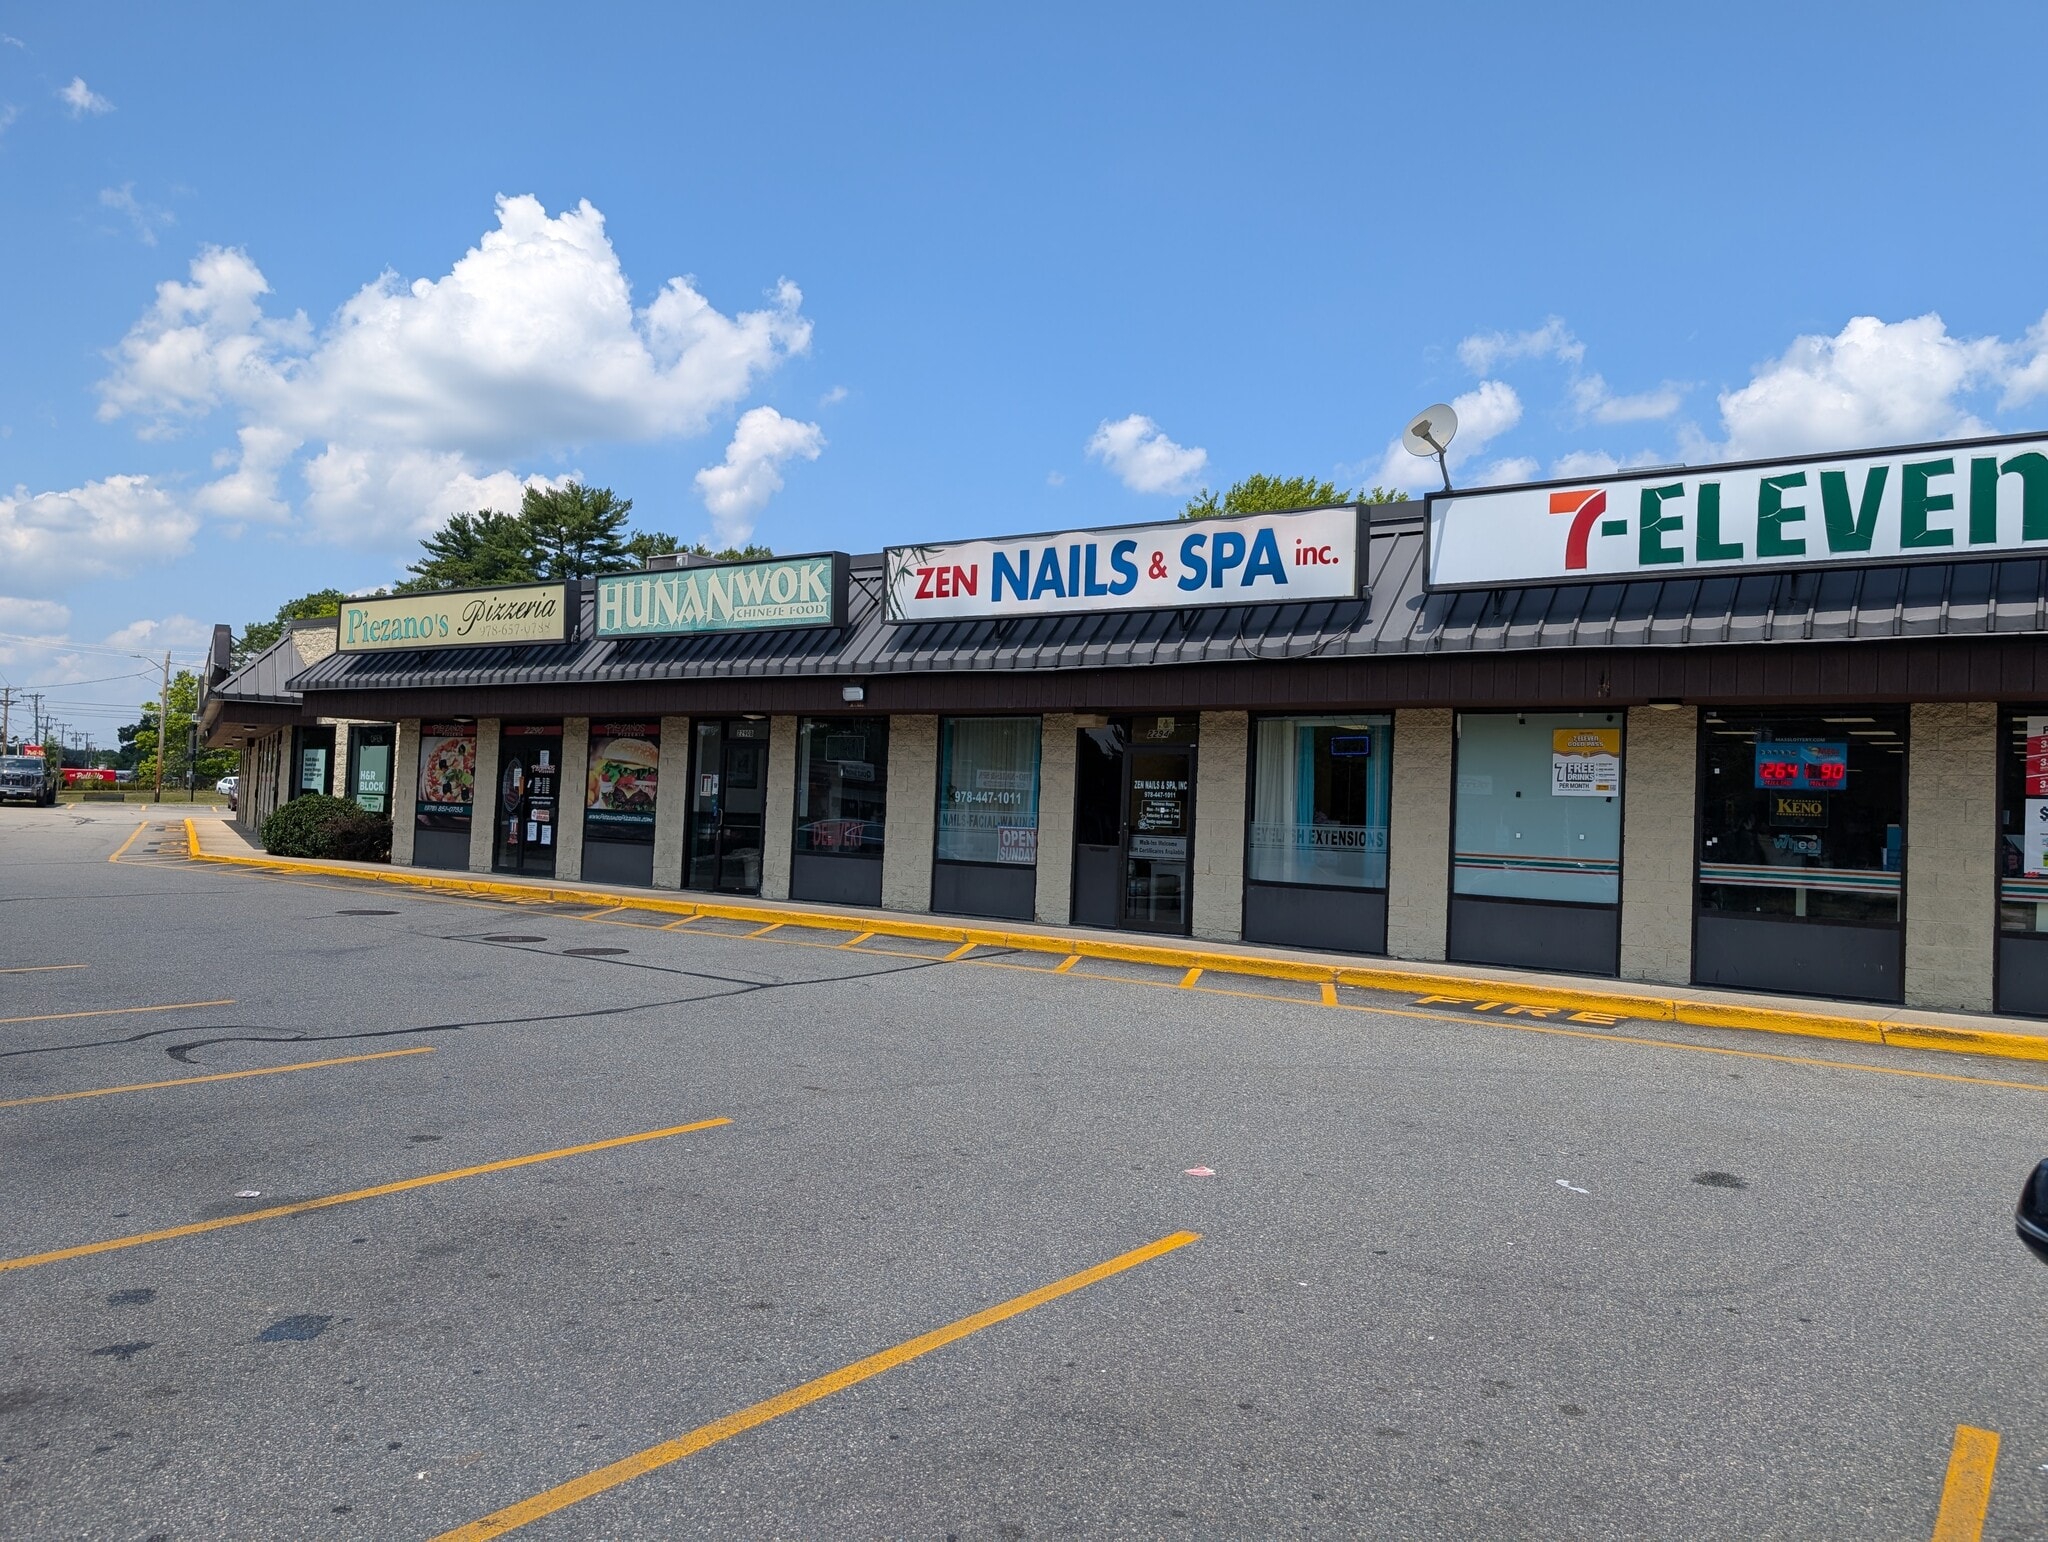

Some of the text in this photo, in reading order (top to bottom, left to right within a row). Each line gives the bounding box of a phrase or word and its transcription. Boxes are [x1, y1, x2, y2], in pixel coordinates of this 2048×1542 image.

[915, 527, 1340, 602] ZEN NAILS & SPA inc.
[736, 602, 824, 619] CHINESE FOOD
[346, 592, 557, 644] Piezano's Pizzeria
[1567, 762, 1594, 773] FREE
[360, 770, 376, 780] H&R
[1568, 773, 1594, 781] DRINKS
[360, 781, 384, 791] BLOCK
[1134, 780, 1143, 789] ZEN
[1145, 781, 1160, 789] NAILS
[1161, 781, 1165, 789] &
[1178, 781, 1187, 790] INC
[955, 791, 1021, 804] 978-447-1011
[1777, 799, 1822, 813] KENO
[1002, 829, 1034, 847] OPEN
[1311, 829, 1384, 847] EXTENSIONS
[1000, 847, 1035, 861] SUNDAY
